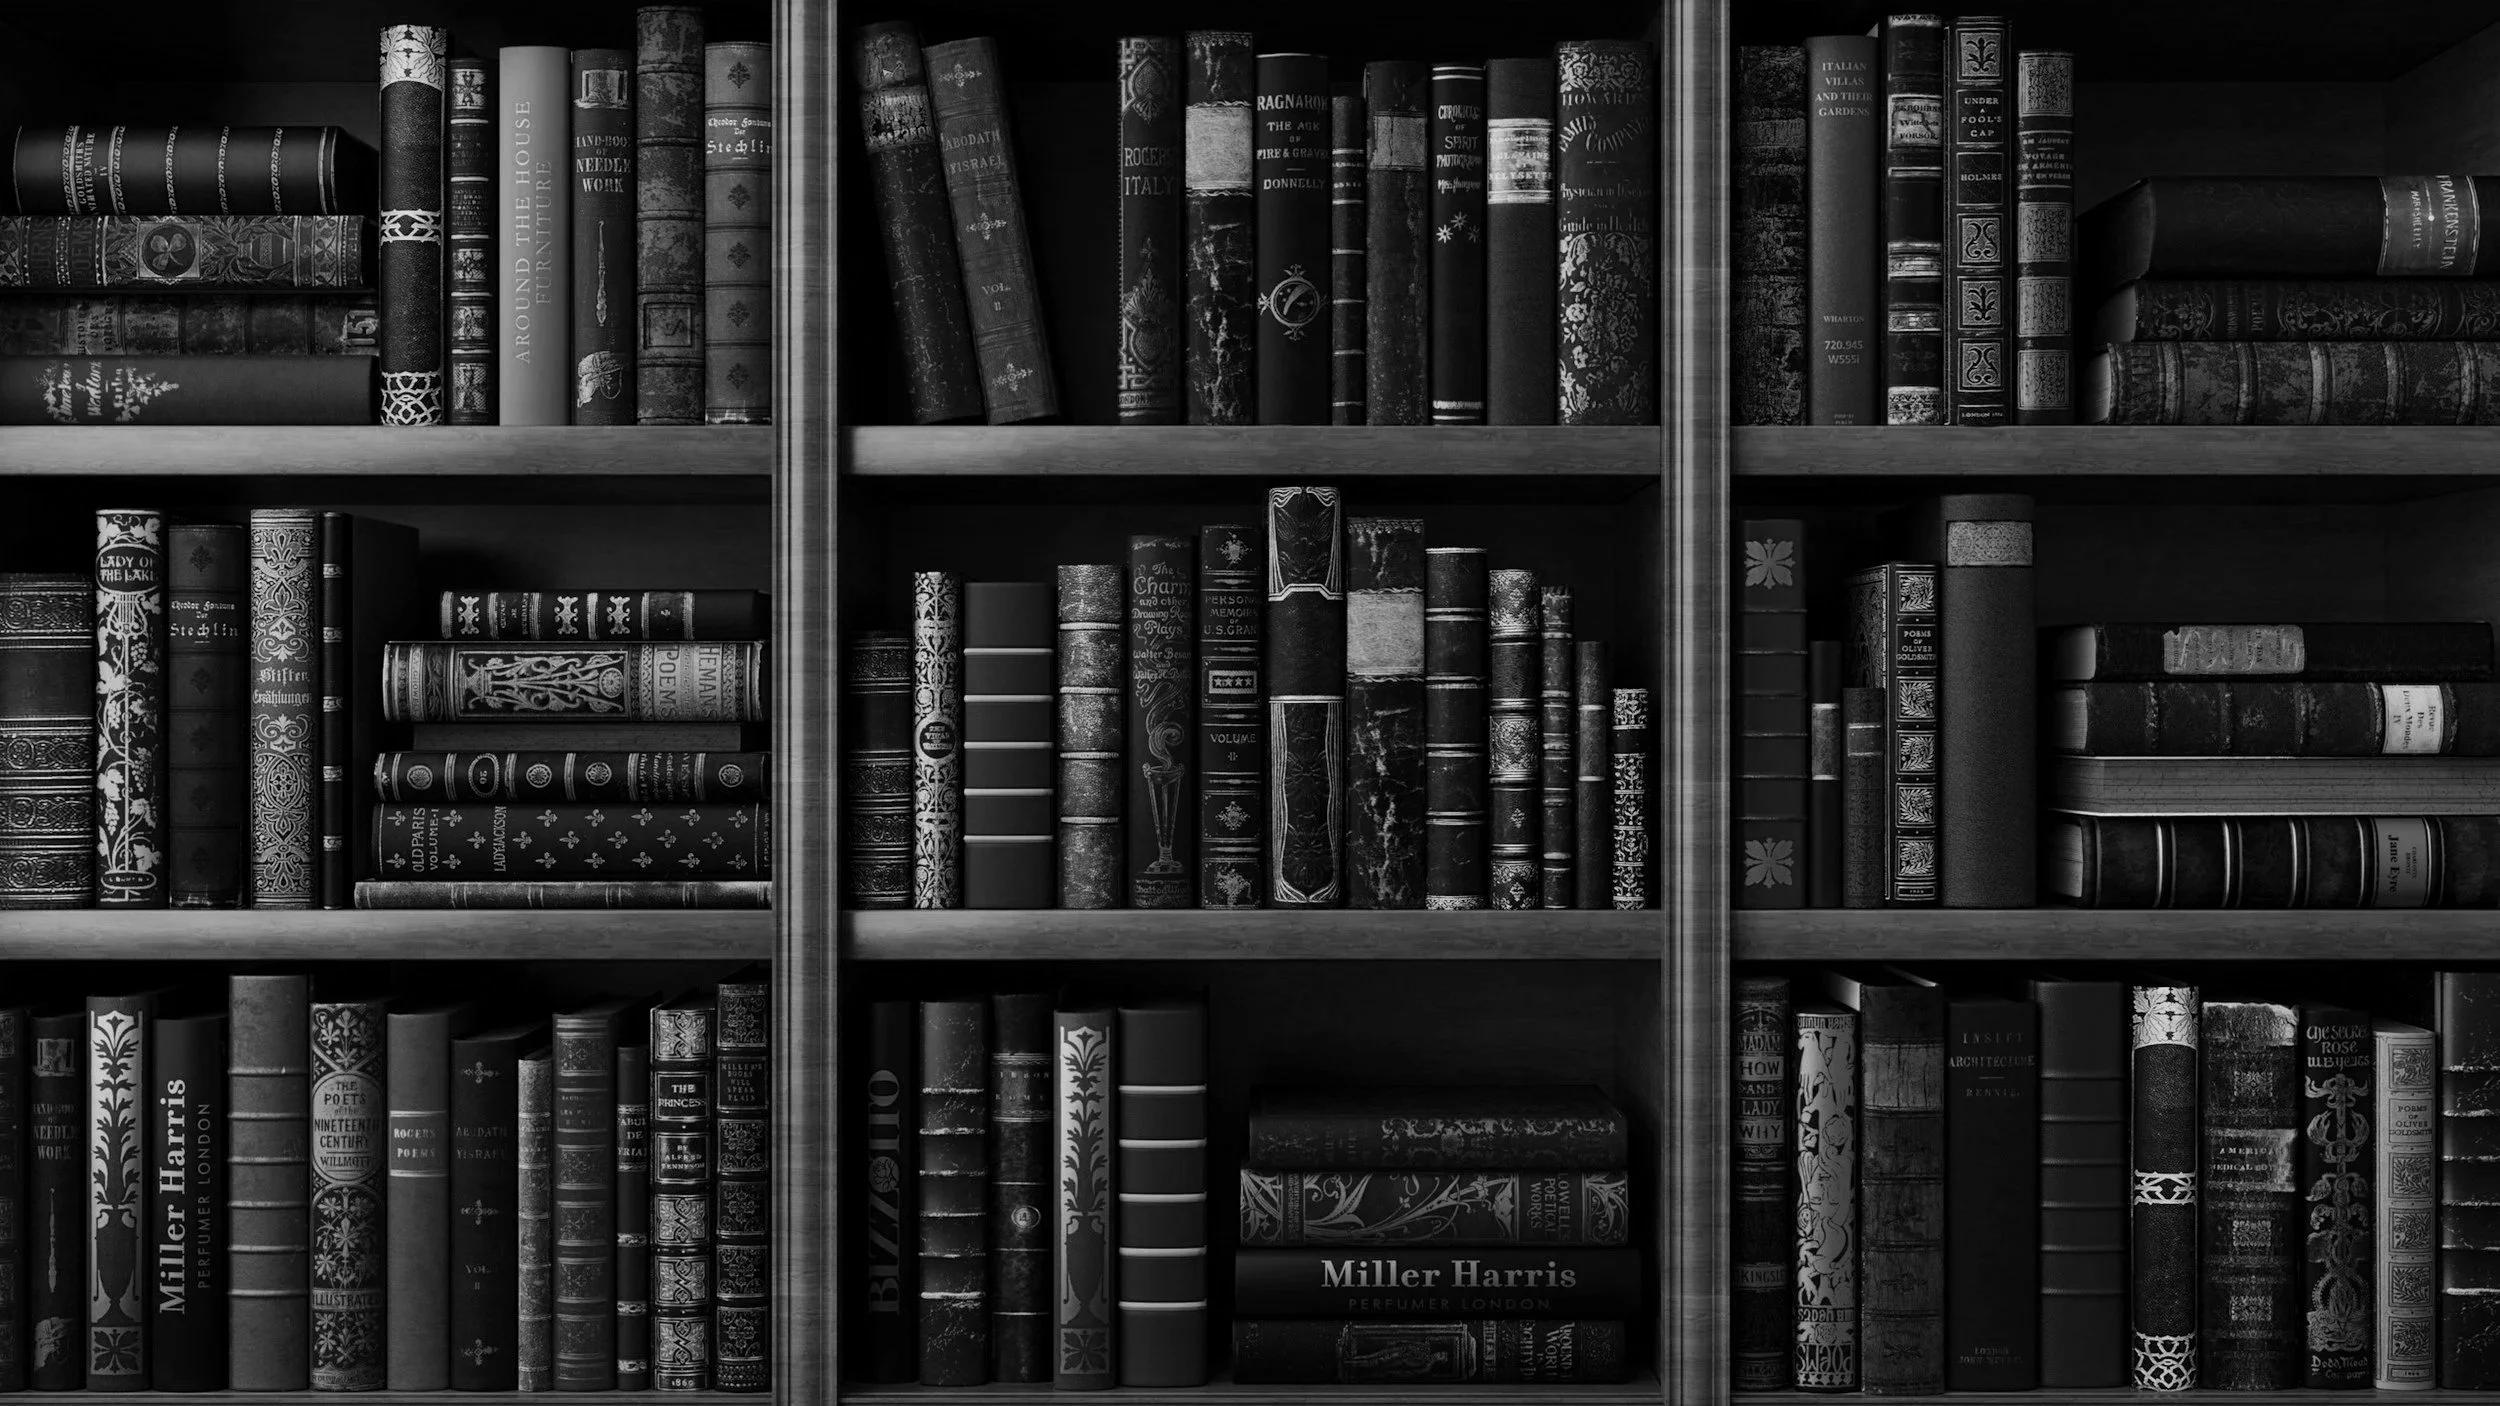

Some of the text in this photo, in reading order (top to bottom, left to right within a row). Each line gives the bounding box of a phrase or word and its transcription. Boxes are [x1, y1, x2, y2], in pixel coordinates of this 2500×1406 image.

[1822, 61, 1868, 71] ITALIAN
[1825, 76, 1865, 86] VILLAS
[1815, 91, 1873, 102] AND THEIR
[1963, 97, 2000, 105] UNDER
[1818, 106, 1871, 117] GARDENS
[1266, 120, 1321, 132] THE AGE
[1961, 114, 2003, 124] FOOL'S
[1969, 129, 1995, 138] CAP
[1444, 135, 1479, 151] SPIRIT
[1263, 177, 1326, 191] DONNELLY
[1960, 173, 2003, 182] HOLMES
[83, 169, 99, 214] NIMATED
[582, 178, 625, 193] WORK
[1123, 174, 1175, 197] ITALY
[2434, 174, 2460, 271] FRANKENSTEIN
[515, 101, 532, 364] AROUND THE HOUSE
[535, 160, 553, 305] FURNITURE
[1822, 315, 1865, 323] WHARTON
[1824, 340, 1864, 350] 720.945
[1827, 353, 1860, 364] W555i
[100, 555, 135, 568] LADY
[1152, 561, 1174, 576] The
[100, 568, 123, 583] THE
[1133, 576, 1193, 596] Charm
[1139, 596, 1159, 607] and
[1131, 607, 1170, 622] Drawing
[169, 622, 239, 638] Stechlin
[1143, 619, 1184, 640] Plays
[1903, 630, 1932, 638] POEMS
[1901, 645, 1933, 653] OLIVER
[657, 646, 680, 718] POEMS
[699, 646, 720, 718] HEMANS
[1210, 733, 1257, 744] VOLUME
[493, 806, 508, 850] JACKSON
[2387, 834, 2401, 893] Jane Eyre
[1739, 1060, 1780, 1076] HOW
[1948, 1054, 2036, 1068] ARCHITECTURE
[336, 1080, 358, 1091] THE
[670, 1083, 697, 1094] THE
[1746, 1083, 1775, 1095] AND
[324, 1092, 368, 1105] POETS
[1742, 1099, 1780, 1116] LADY
[1739, 1125, 1780, 1140] WHY
[320, 1135, 370, 1149] CENTURY
[36, 1145, 72, 1160] WORK
[396, 1147, 437, 1160] POEMS
[159, 1078, 187, 1317] Miller Harris
[197, 1103, 212, 1290] PERFUMER LONDON
[1529, 1181, 1543, 1230] WORKS
[1320, 1259, 1577, 1288] Miller Harris
[1349, 1298, 1551, 1311] PERFUMER LONDON
